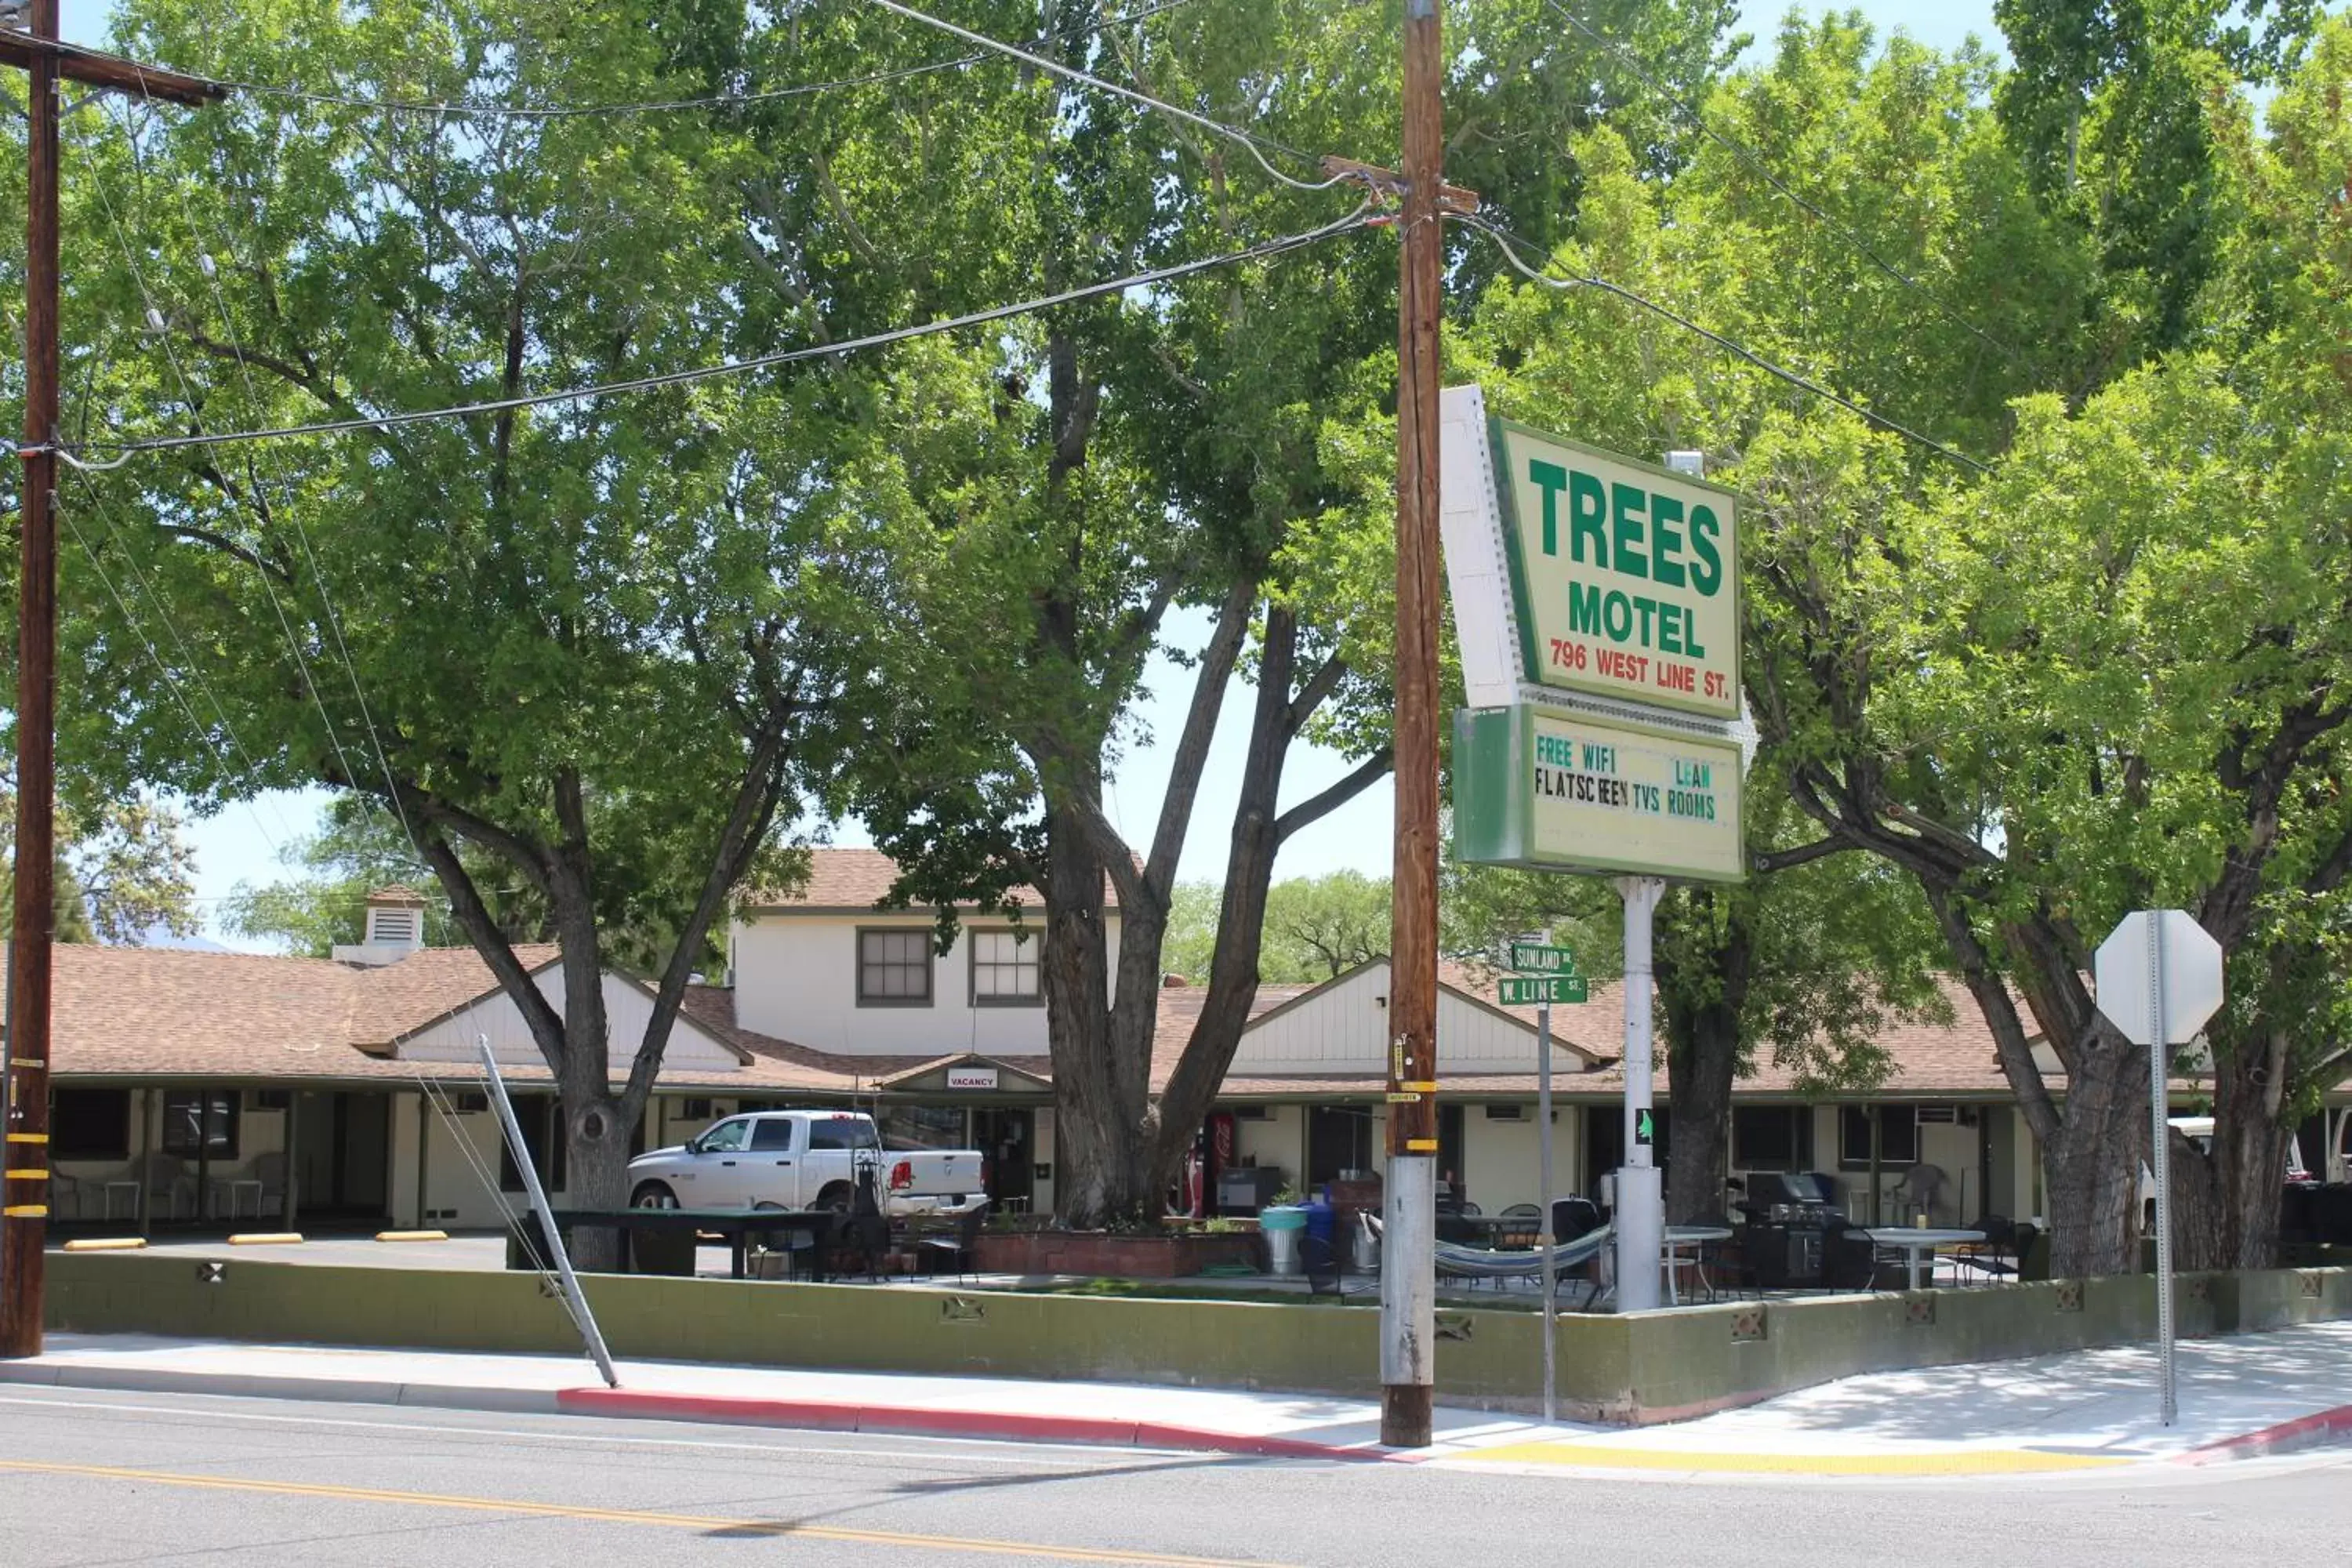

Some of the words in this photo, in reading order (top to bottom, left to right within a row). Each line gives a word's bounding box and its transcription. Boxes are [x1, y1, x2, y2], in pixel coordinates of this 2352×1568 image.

[1530, 459, 1722, 597] TREES
[1569, 581, 1705, 659] MOTEL
[1550, 639, 1587, 670] 796
[1596, 648, 1649, 683] WEST
[1657, 661, 1694, 692] LINE
[1704, 671, 1729, 700] ST.
[1537, 735, 1572, 767] FREE
[1583, 743, 1616, 774] WIFI
[1633, 783, 1660, 811] TVS
[1668, 789, 1715, 821] ROOMS
[1517, 948, 1559, 969] SUNLAND
[1503, 982, 1515, 1000] W.
[1522, 980, 1559, 1000] LINE
[951, 1077, 993, 1086] VACANCY
